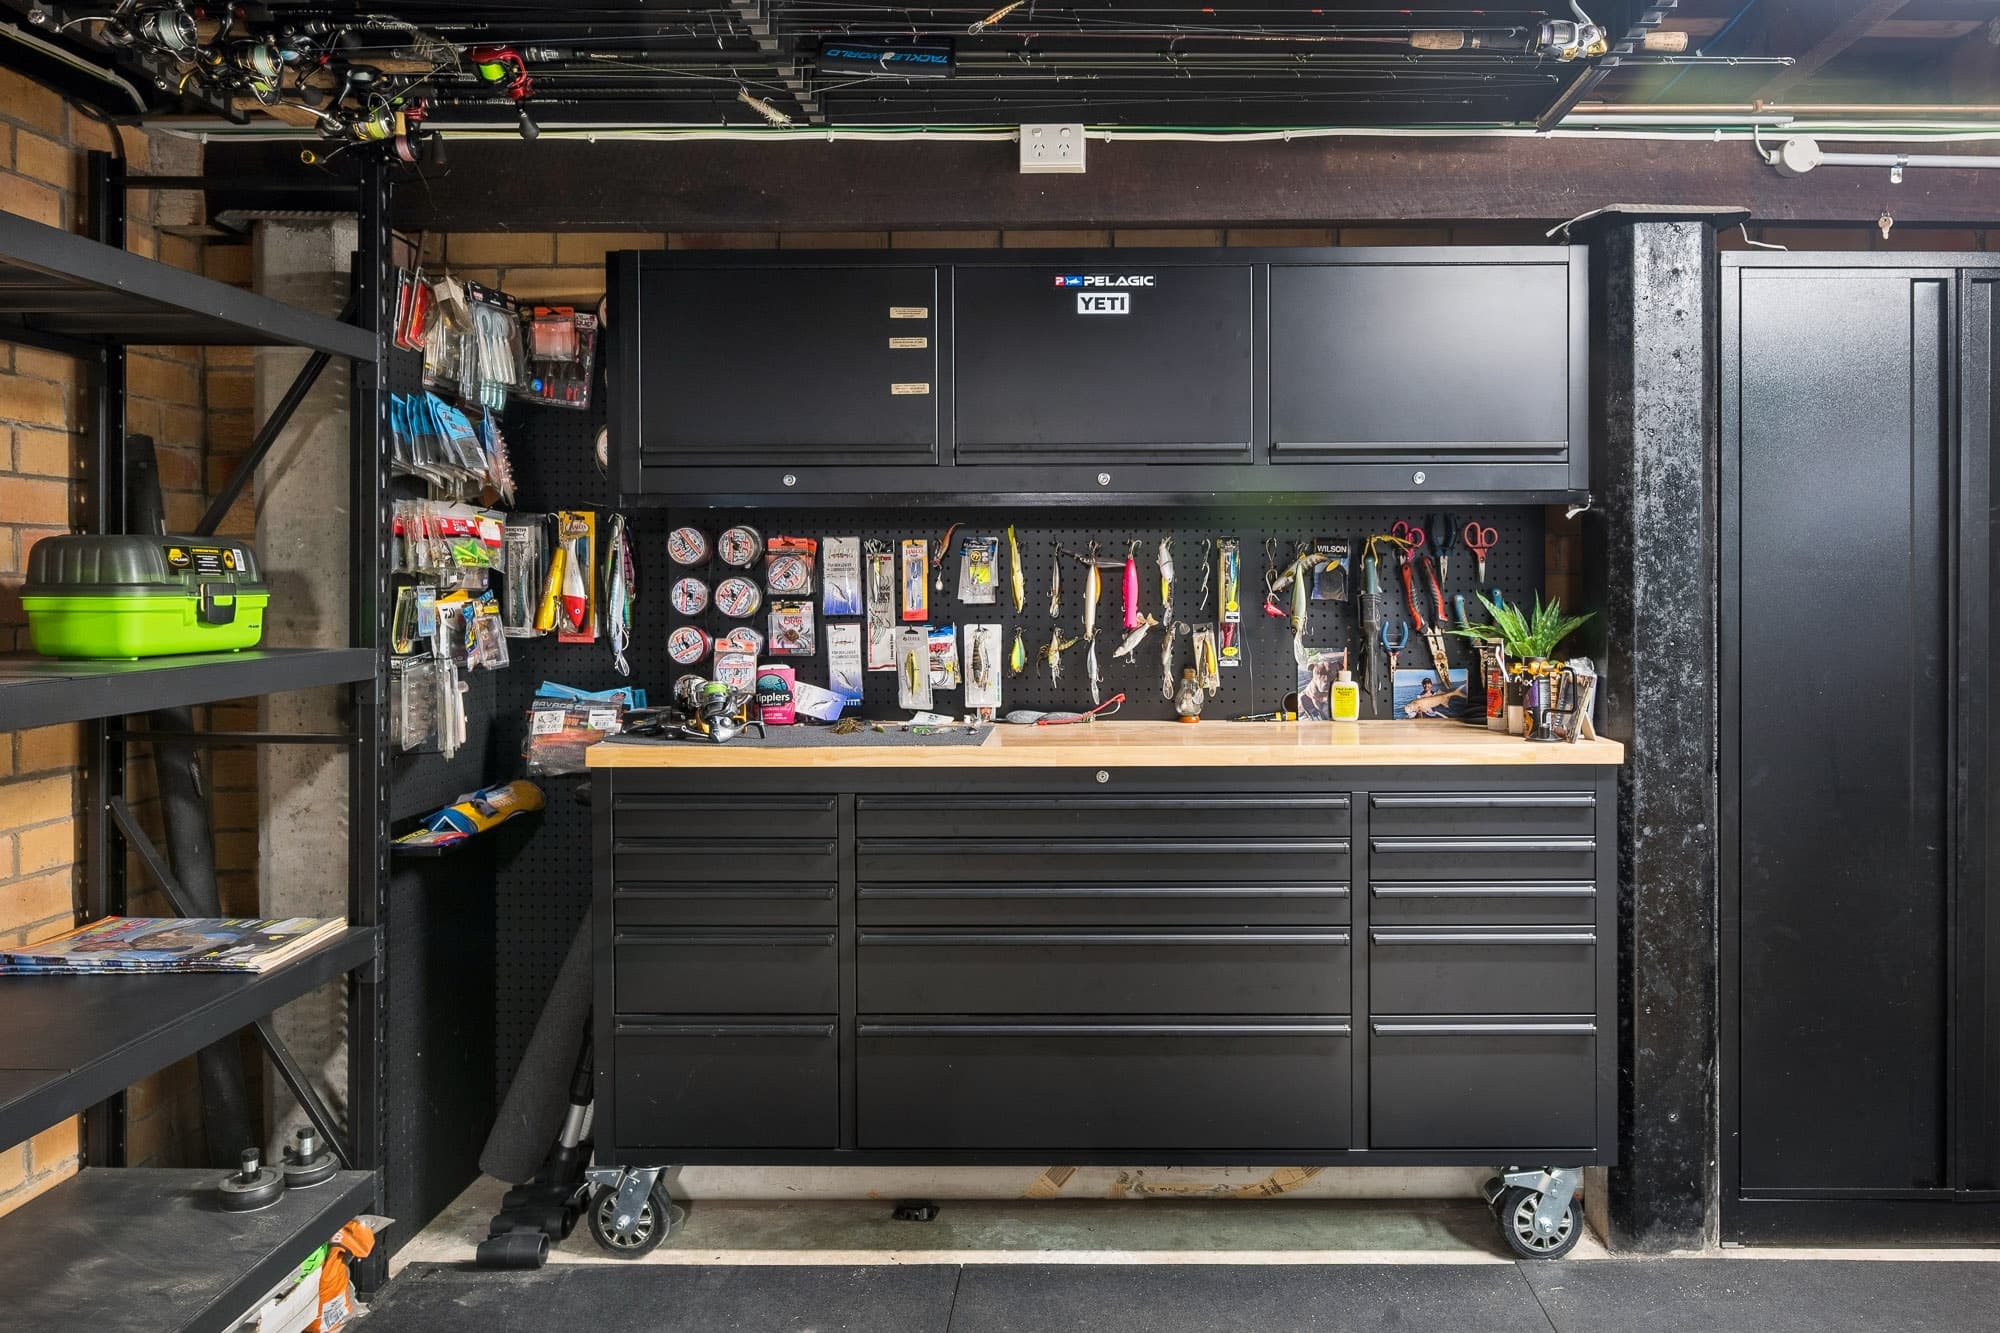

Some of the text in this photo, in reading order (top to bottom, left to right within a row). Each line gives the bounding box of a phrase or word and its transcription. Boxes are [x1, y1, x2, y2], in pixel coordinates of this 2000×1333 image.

[1084, 276, 1154, 287] PELAGIC
[1081, 297, 1126, 310] YETI
[1317, 545, 1348, 553] WILSON
[755, 692, 791, 704] Tipplers
